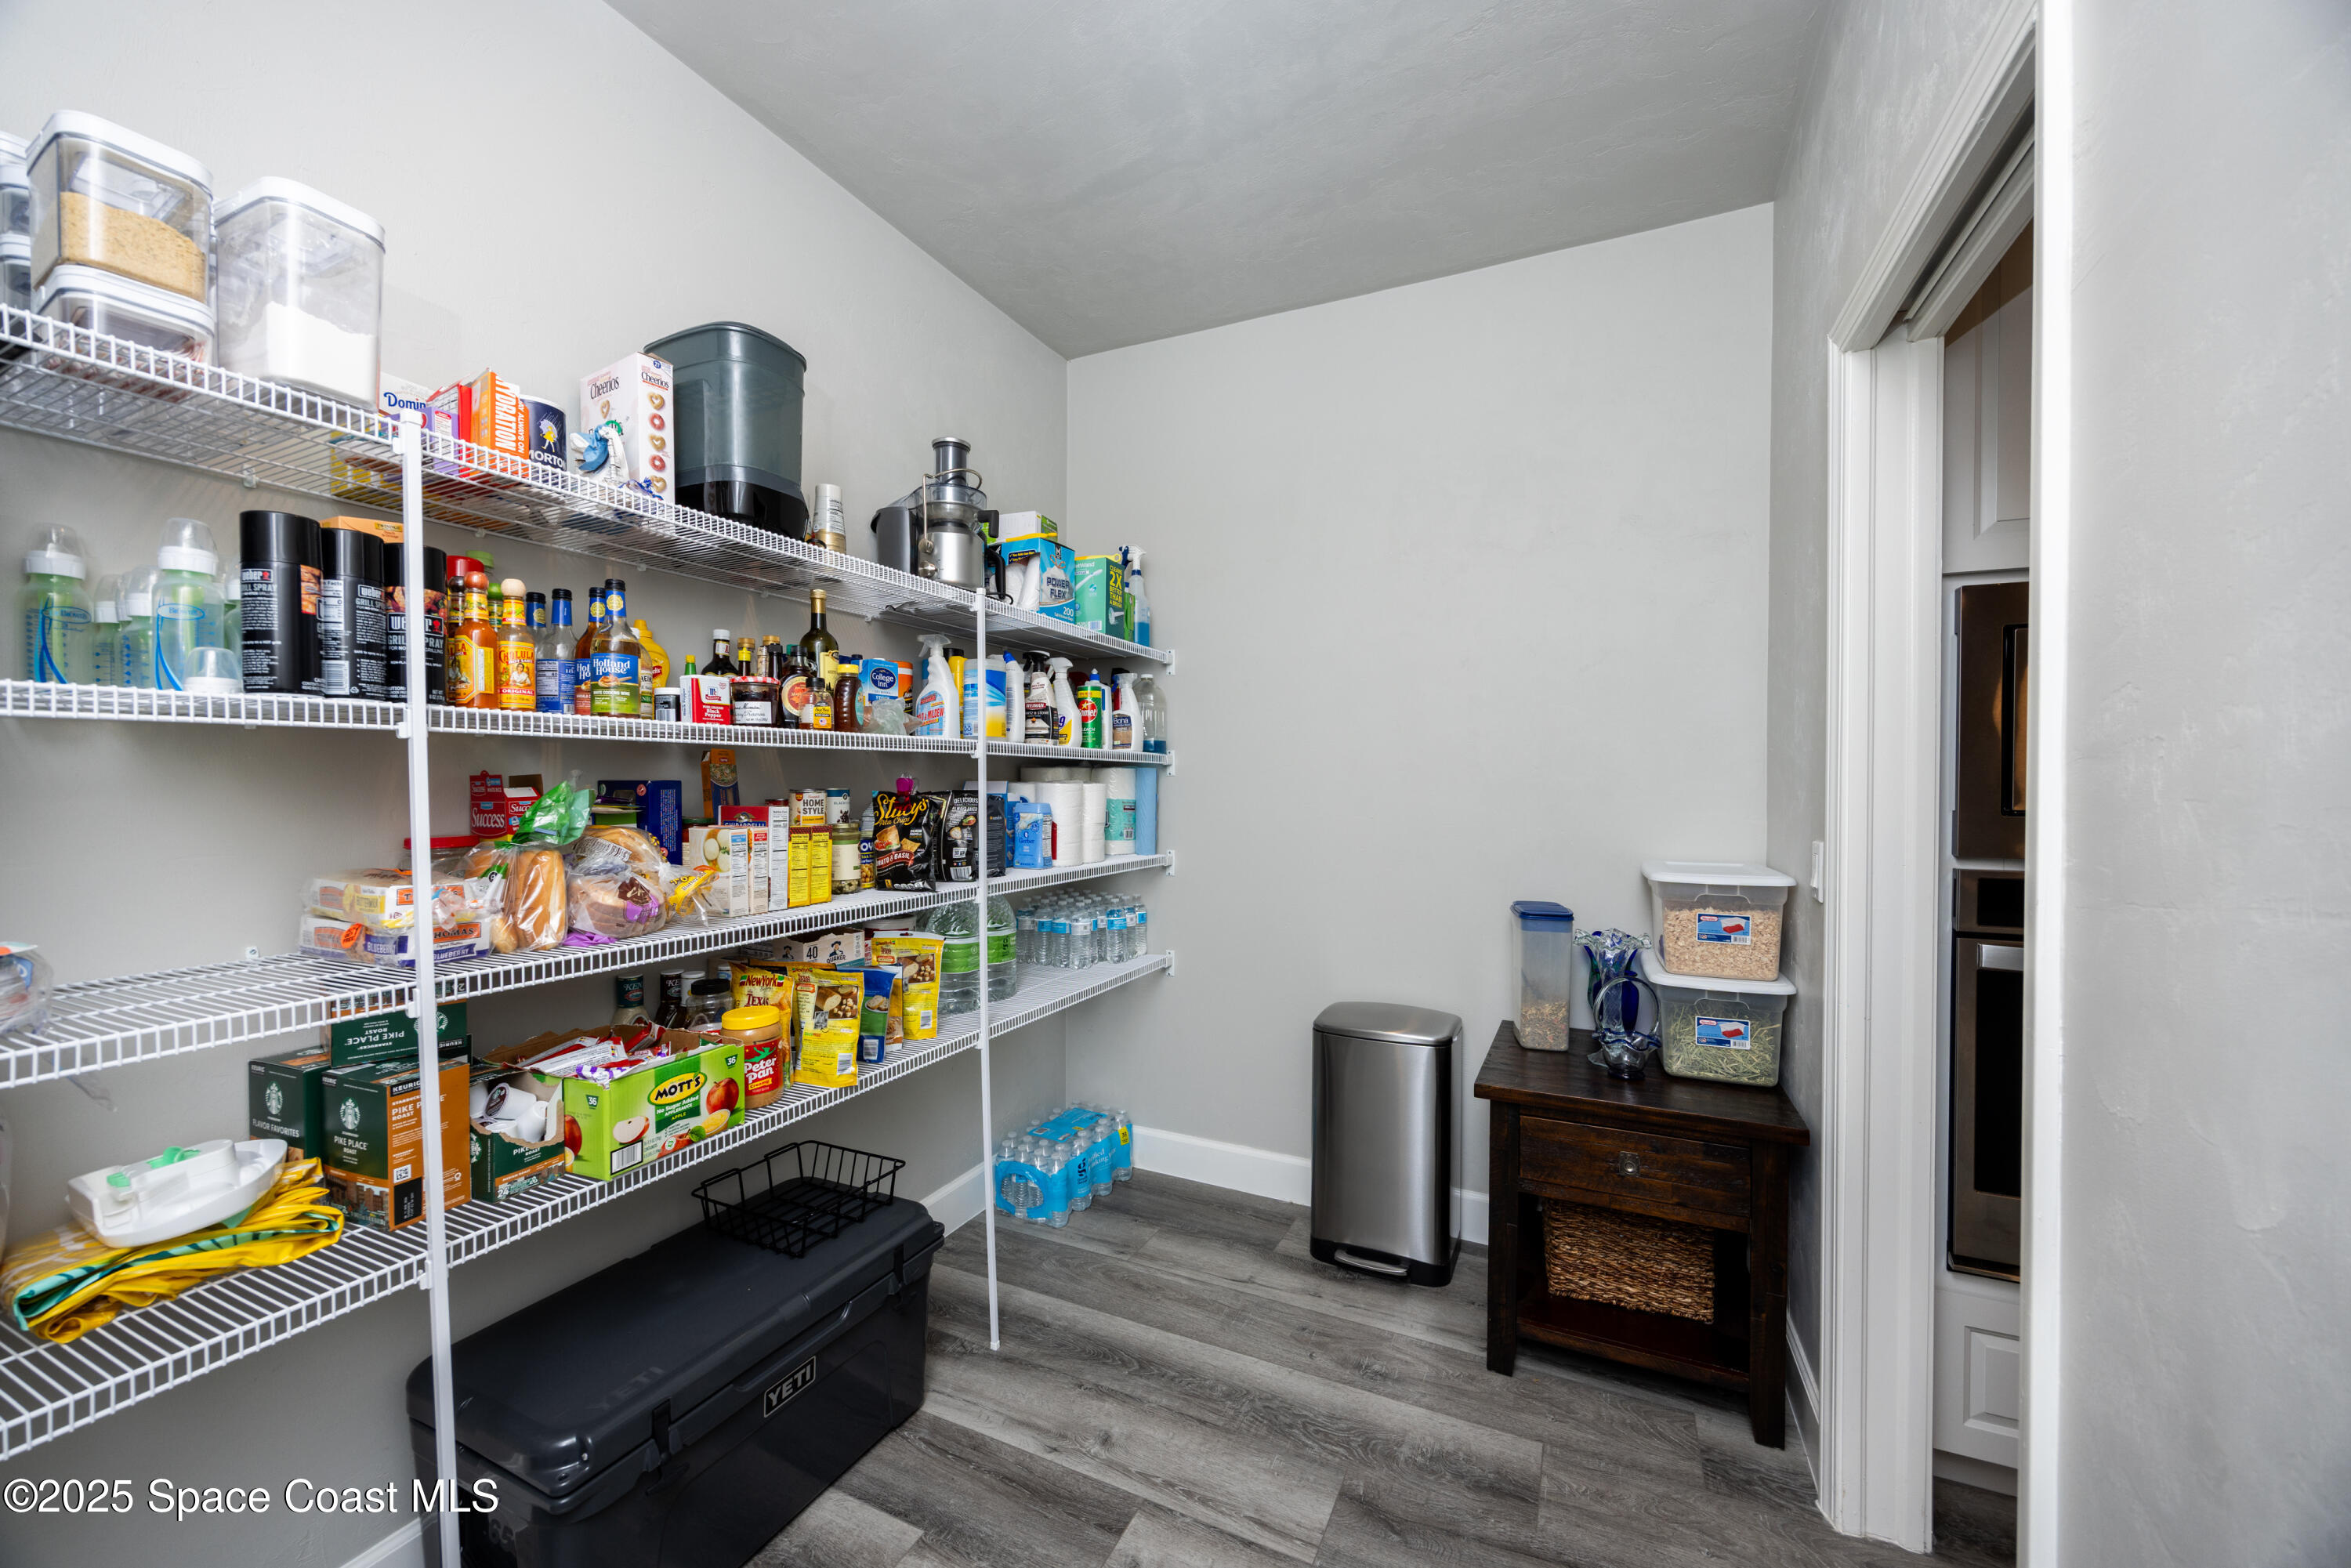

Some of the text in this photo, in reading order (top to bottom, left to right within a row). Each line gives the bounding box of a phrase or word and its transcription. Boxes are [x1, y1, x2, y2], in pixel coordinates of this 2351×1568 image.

[641, 371, 669, 389] Cheerios
[590, 376, 619, 400] Cheerios
[517, 442, 525, 454] ON
[1047, 577, 1070, 588] POWER
[1110, 571, 1122, 590] 2X
[1050, 588, 1067, 599] FLEX
[1110, 592, 1122, 603] THAN
[1063, 607, 1074, 617] 200
[499, 650, 534, 664] CHOLULA
[593, 658, 630, 669] Holland
[596, 666, 628, 675] House
[871, 672, 894, 683] College
[928, 708, 945, 720] MILDEW
[802, 798, 824, 807] HOME
[472, 807, 505, 828] Success
[893, 817, 911, 826] Chips
[806, 946, 818, 960] 40
[826, 954, 846, 964] QUAKER
[746, 994, 769, 1006] TEXAS
[347, 1030, 404, 1045] PIKE PLACE
[726, 1056, 737, 1066] 36
[744, 1057, 777, 1074] Peter
[654, 1076, 701, 1101] MOTT'S
[750, 1079, 770, 1088] Creamy
[588, 1097, 597, 1106] 36
[665, 1102, 682, 1112] Sugar
[682, 1095, 700, 1106] Added
[392, 1103, 414, 1116] PIKE
[392, 1110, 414, 1121] ROAST
[665, 1103, 693, 1117] APPLESAUCE
[671, 1111, 687, 1121] APPLE
[252, 1118, 299, 1138] FLAVOR FAVORITES
[334, 1135, 368, 1150] PIKE PLACE
[768, 1364, 811, 1407] YETI
